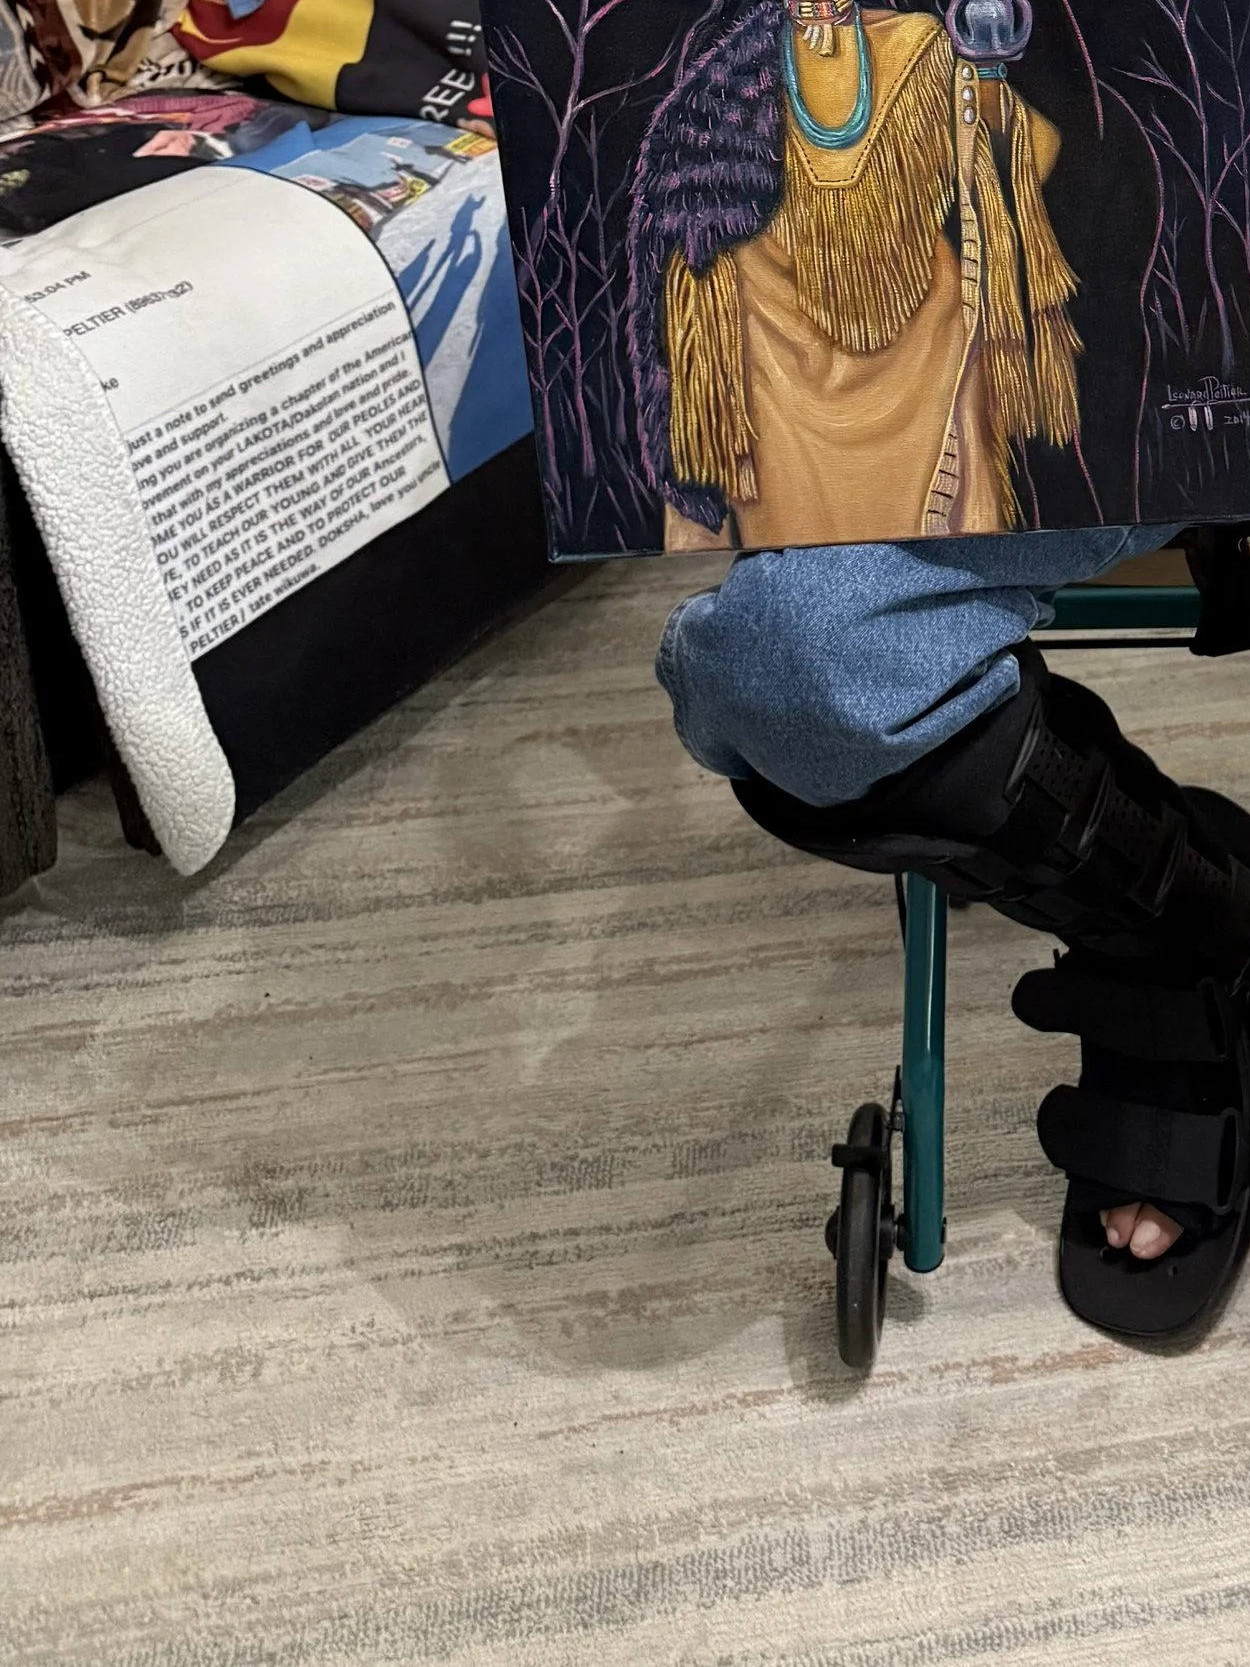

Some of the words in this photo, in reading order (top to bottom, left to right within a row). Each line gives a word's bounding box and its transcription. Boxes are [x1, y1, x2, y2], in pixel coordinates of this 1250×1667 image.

[62, 306, 126, 337] PELTIER
[127, 431, 153, 455] just
[154, 427, 163, 438] a
[165, 411, 192, 432] note
[194, 403, 208, 416] to
[209, 384, 236, 409] send
[239, 352, 300, 394] greetings
[302, 337, 325, 358] and
[326, 301, 396, 345] appreciation
[152, 503, 177, 526] that
[178, 487, 204, 510] with
[205, 477, 223, 493] my
[225, 429, 311, 483] appreciations
[312, 414, 333, 434] and
[334, 399, 357, 419] love
[359, 385, 380, 405] and
[154, 438, 178, 460] and
[180, 412, 228, 446] support.
[158, 460, 182, 482] you
[184, 448, 202, 465] are
[204, 412, 267, 453] organizing
[270, 406, 279, 417] a
[281, 380, 326, 411] chapter
[328, 367, 340, 383] of
[342, 358, 362, 375] the
[178, 508, 203, 530] YOU
[205, 496, 221, 515] AS
[223, 490, 232, 504] A
[232, 455, 296, 496] WARRIOR
[298, 439, 325, 462] FOR
[328, 422, 351, 443] OUR
[352, 393, 397, 427] PEOLES
[398, 378, 421, 400] AND
[180, 527, 209, 552] WILL
[208, 492, 261, 532] RESPECT
[263, 470, 305, 499] THEM
[307, 450, 339, 476] WITH
[339, 436, 360, 455] ALL
[364, 412, 397, 438] YOUR
[194, 465, 210, 479] on
[211, 448, 235, 472] your
[237, 389, 341, 454] LAKOTA/Dakotan
[342, 368, 379, 395] nation
[379, 355, 399, 373] and
[183, 553, 200, 571] TO
[201, 527, 240, 558] TEACH
[241, 509, 269, 533] OUR
[270, 481, 321, 514] YOUNG
[323, 463, 346, 486] AND
[347, 446, 375, 470] GIVE
[377, 427, 407, 452] THEM
[408, 410, 428, 430] THE
[185, 594, 204, 613] TO
[205, 573, 233, 601] KEEP
[234, 547, 275, 580] PEACE
[276, 529, 306, 554] AND
[308, 517, 326, 535] TO
[327, 482, 377, 523] PROTECT
[379, 466, 407, 488] OUR
[190, 615, 203, 632] IF
[204, 605, 217, 623] IT
[218, 597, 231, 613] IS
[231, 576, 262, 604] EVER
[370, 492, 395, 513] love
[397, 480, 418, 499] you
[191, 560, 222, 588] NEED
[224, 548, 240, 567] AS
[240, 540, 252, 555] IT
[254, 529, 268, 545] IS
[268, 513, 298, 535] THE
[299, 495, 328, 521] WAY
[329, 484, 345, 502] OF
[346, 466, 371, 489] OUR
[190, 614, 240, 654] PELTIER
[249, 592, 273, 613] tate
